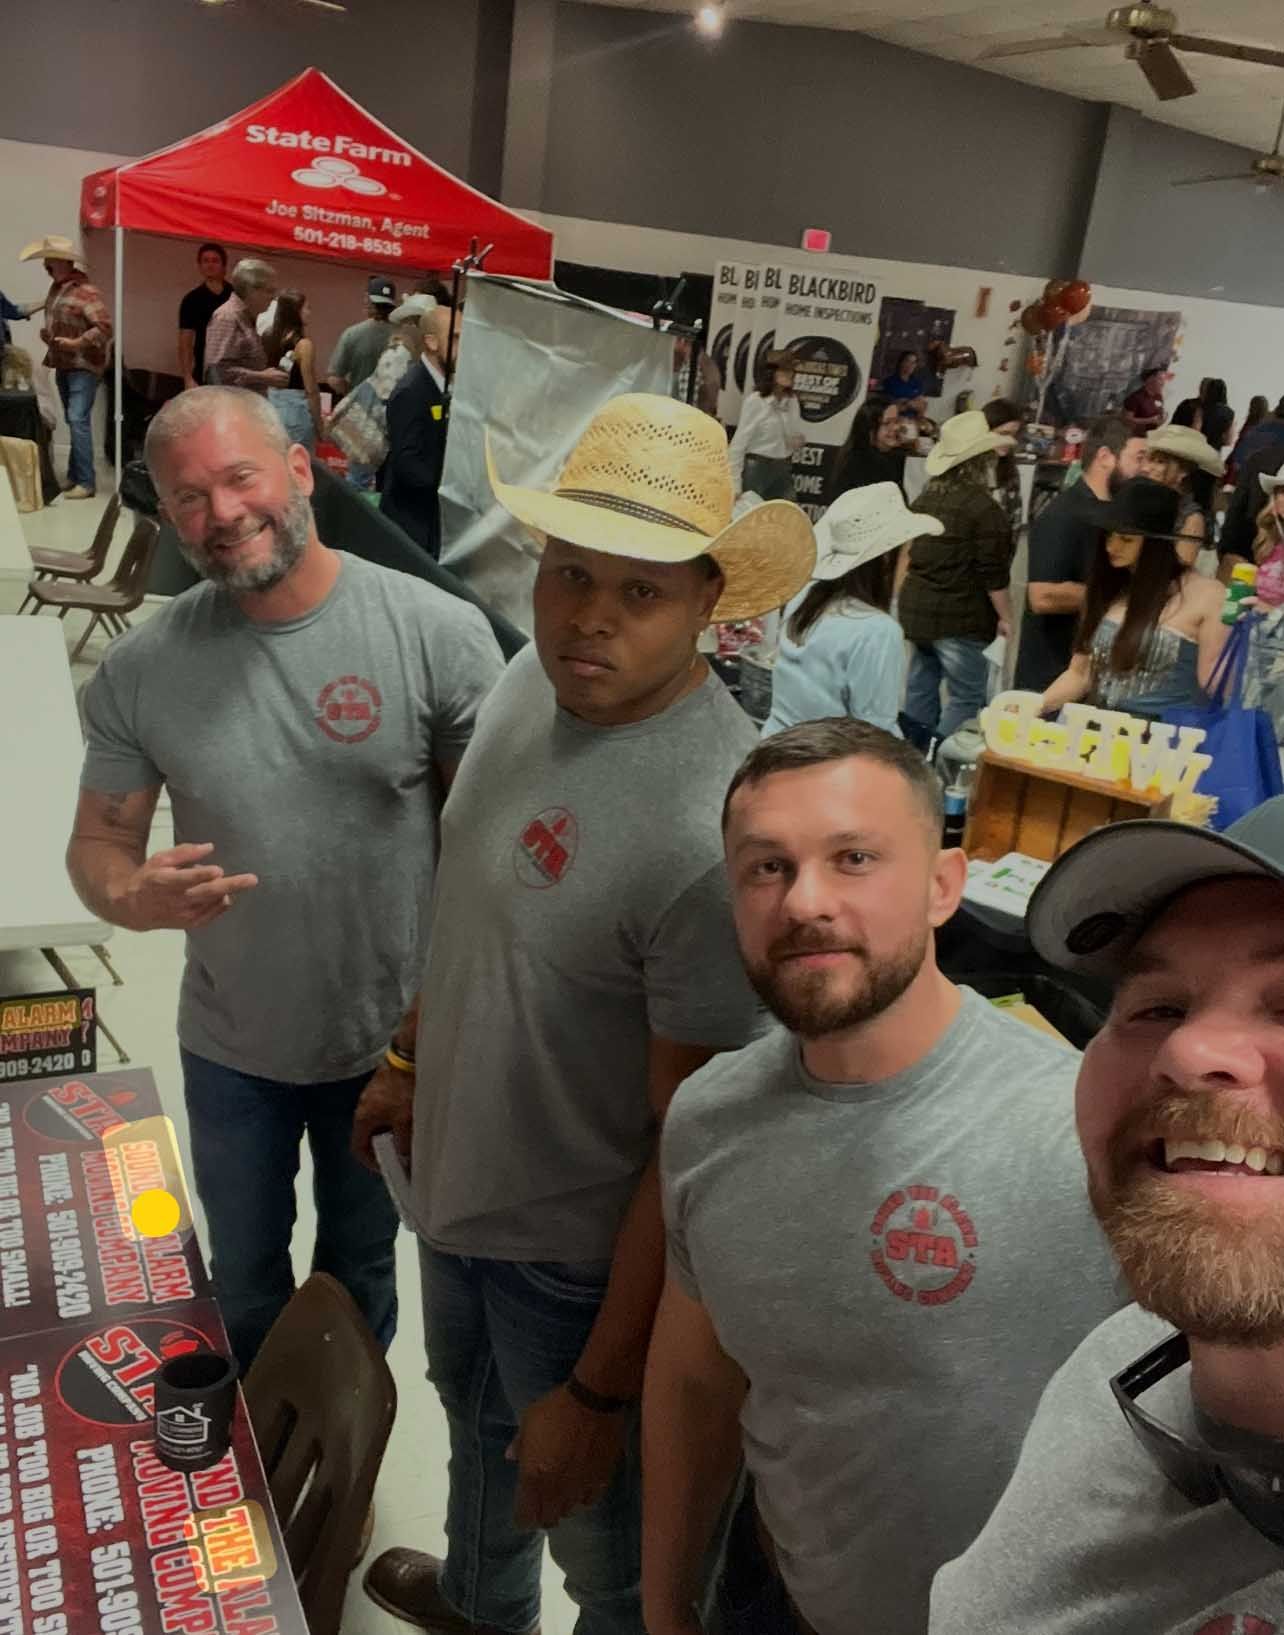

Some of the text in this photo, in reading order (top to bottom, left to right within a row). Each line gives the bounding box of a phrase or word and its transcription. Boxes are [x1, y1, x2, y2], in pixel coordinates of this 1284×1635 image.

[266, 200, 431, 239] Joe Sitzman, Agent
[788, 274, 876, 304] BLACKBIRD
[785, 303, 873, 325] HOME INSPECTIONS
[793, 474, 824, 494] OME
[2, 1000, 77, 1030] ALARM
[39, 1152, 74, 1206] PHONE:
[0, 1218, 25, 1249] TOO
[80, 1148, 149, 1305] MOVING COMPANY
[46, 1209, 92, 1319] 501-909-2420
[13, 1402, 45, 1440] JOB
[16, 1439, 50, 1484] TOO
[20, 1483, 54, 1524] BIG
[77, 1443, 125, 1535] PHONE:
[24, 1524, 58, 1560] OR
[201, 1505, 262, 1576] THE
[28, 1558, 65, 1612] TOO
